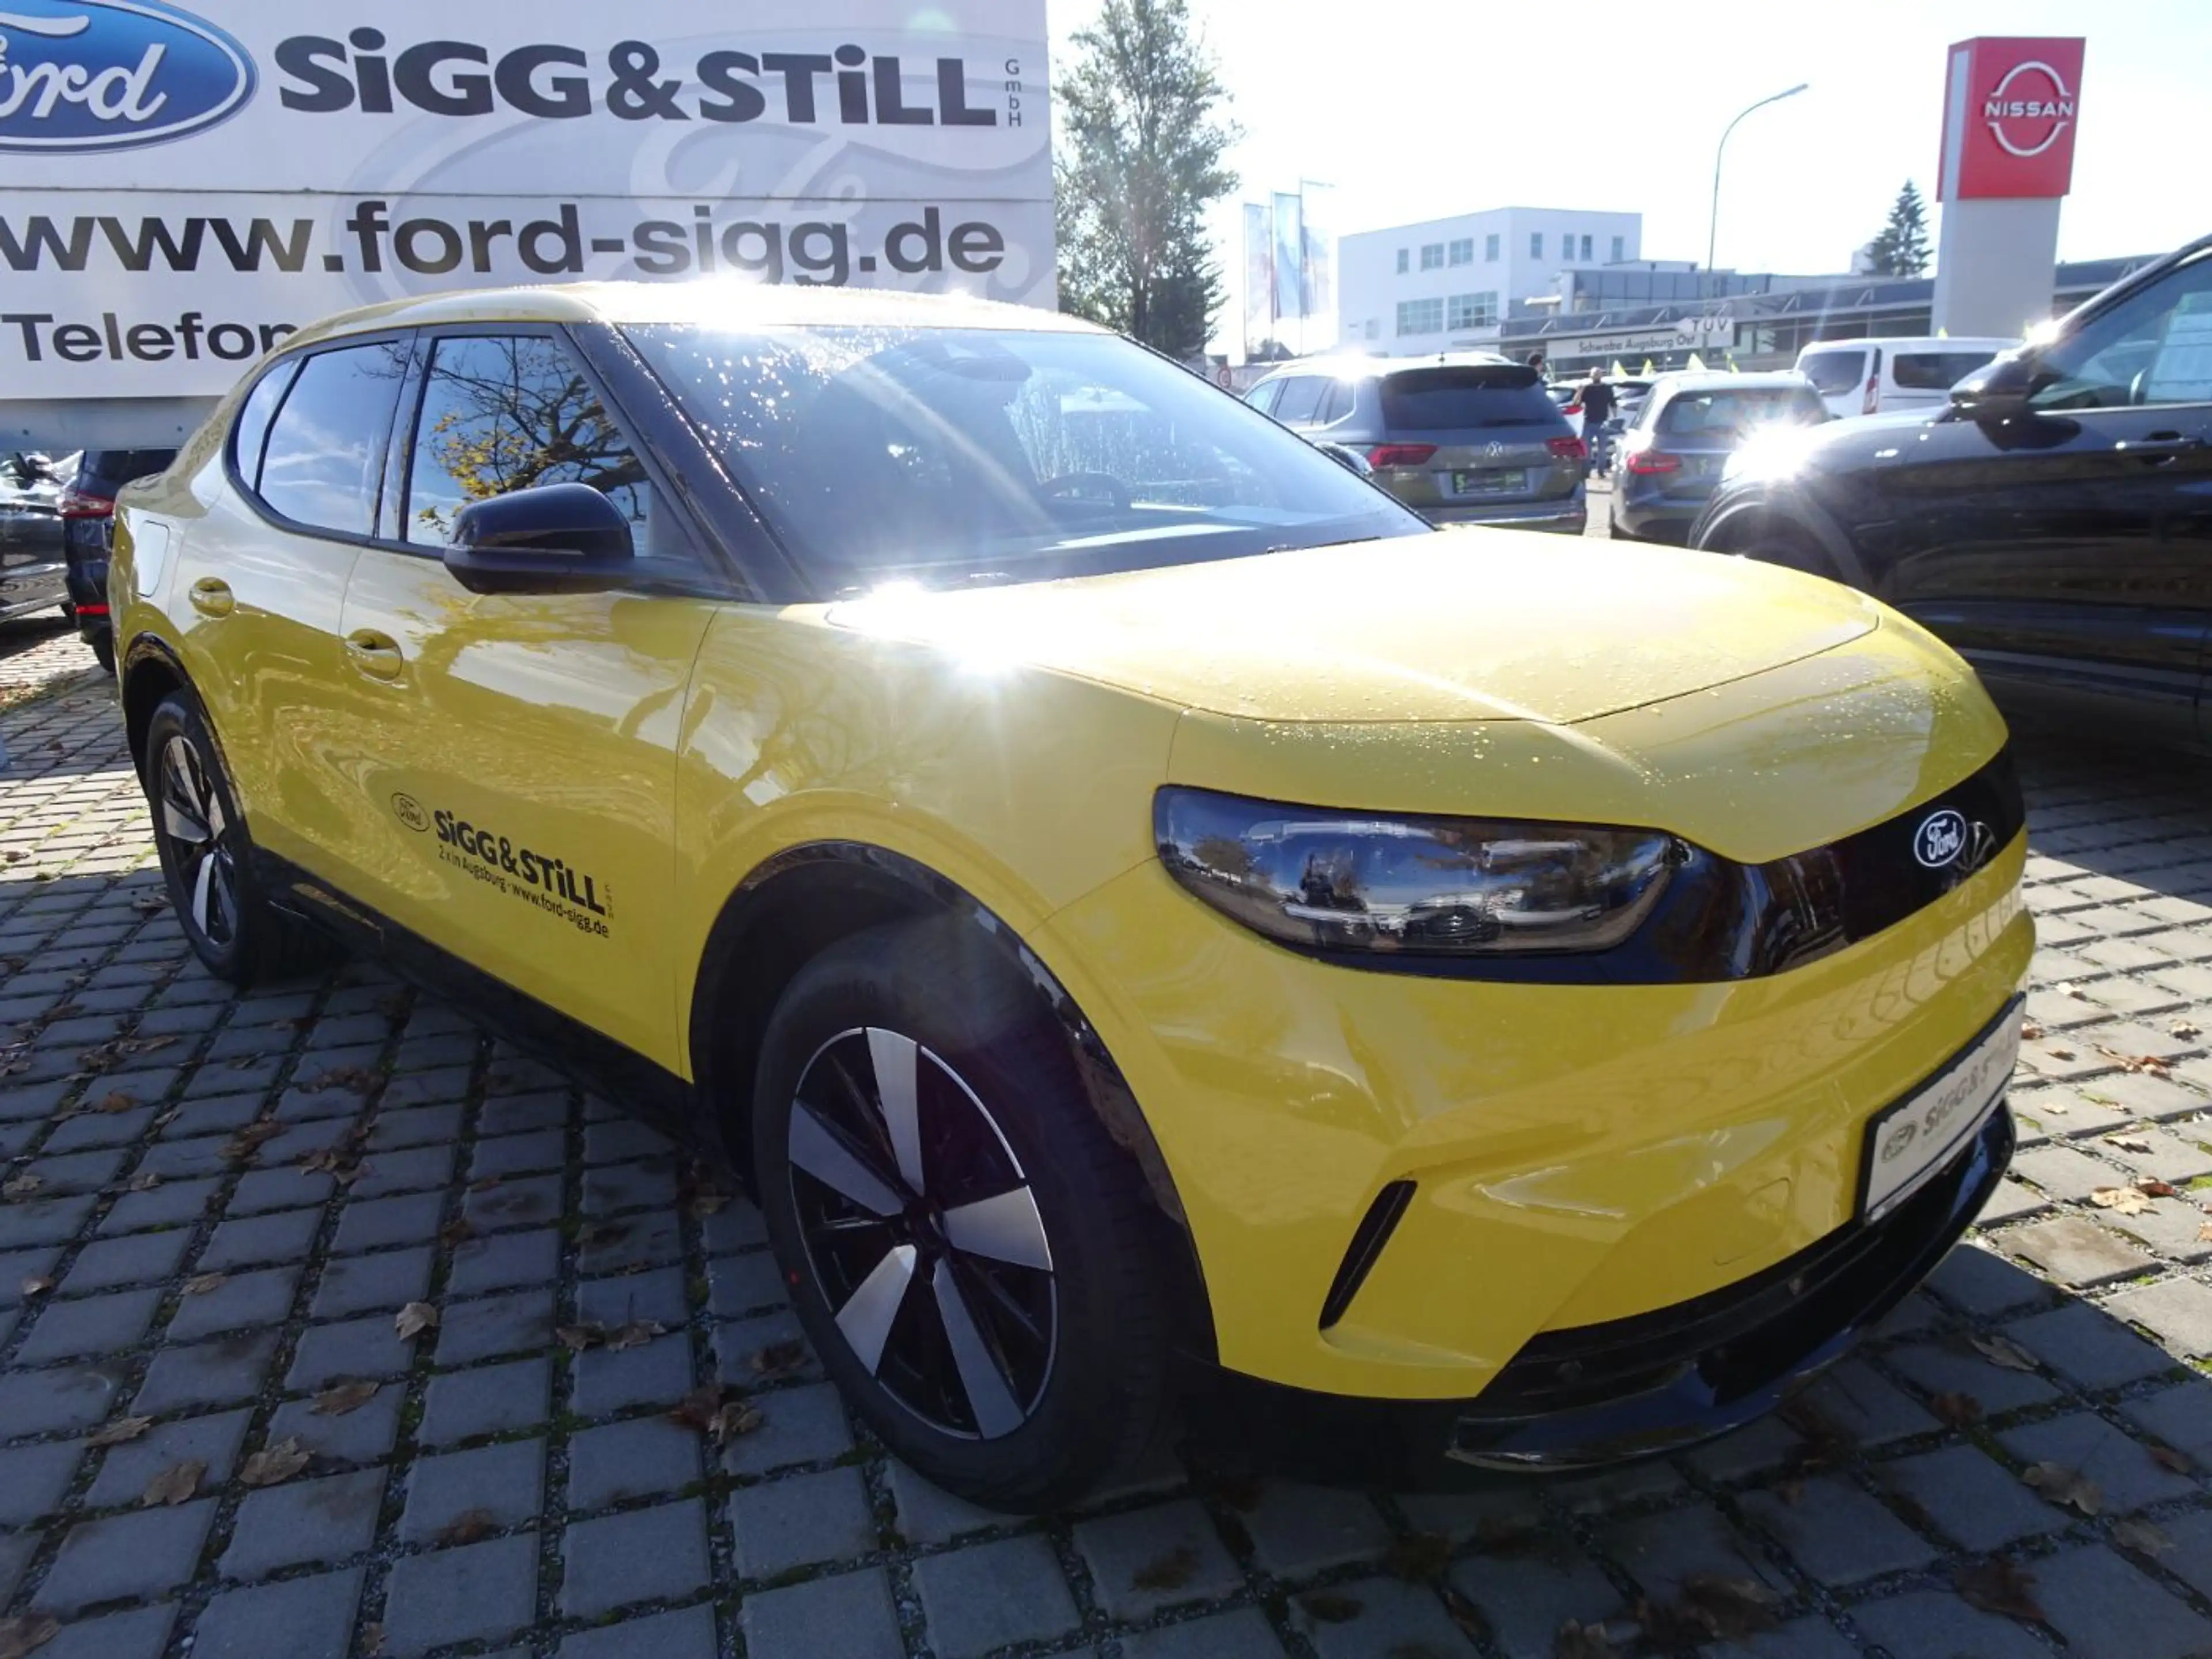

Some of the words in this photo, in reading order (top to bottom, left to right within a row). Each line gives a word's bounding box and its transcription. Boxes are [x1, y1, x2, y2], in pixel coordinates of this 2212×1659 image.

[1005, 58, 1021, 127] GmbH
[1984, 101, 2073, 118] NISSAN
[0, 200, 1005, 287] www.ford-sigg.de
[1927, 819, 1959, 860] Ford
